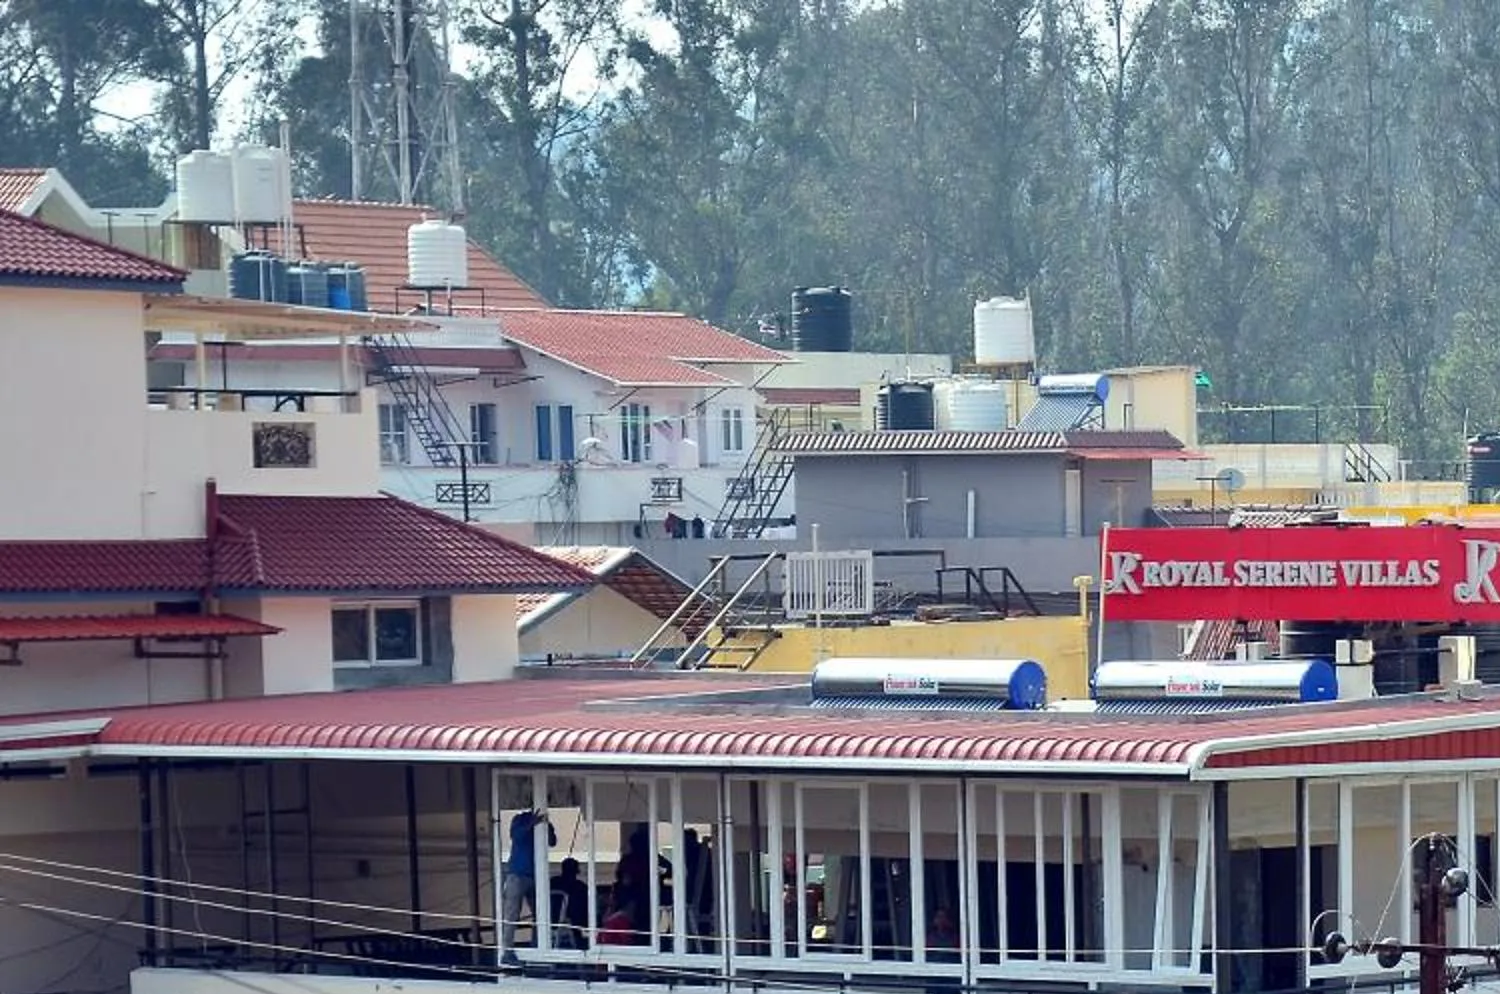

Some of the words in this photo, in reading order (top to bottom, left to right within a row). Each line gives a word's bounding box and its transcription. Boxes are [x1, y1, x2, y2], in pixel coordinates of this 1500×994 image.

[1143, 560, 1231, 587] ROYAL
[1233, 560, 1337, 587] SERENE
[1340, 559, 1440, 587] VILLAS
